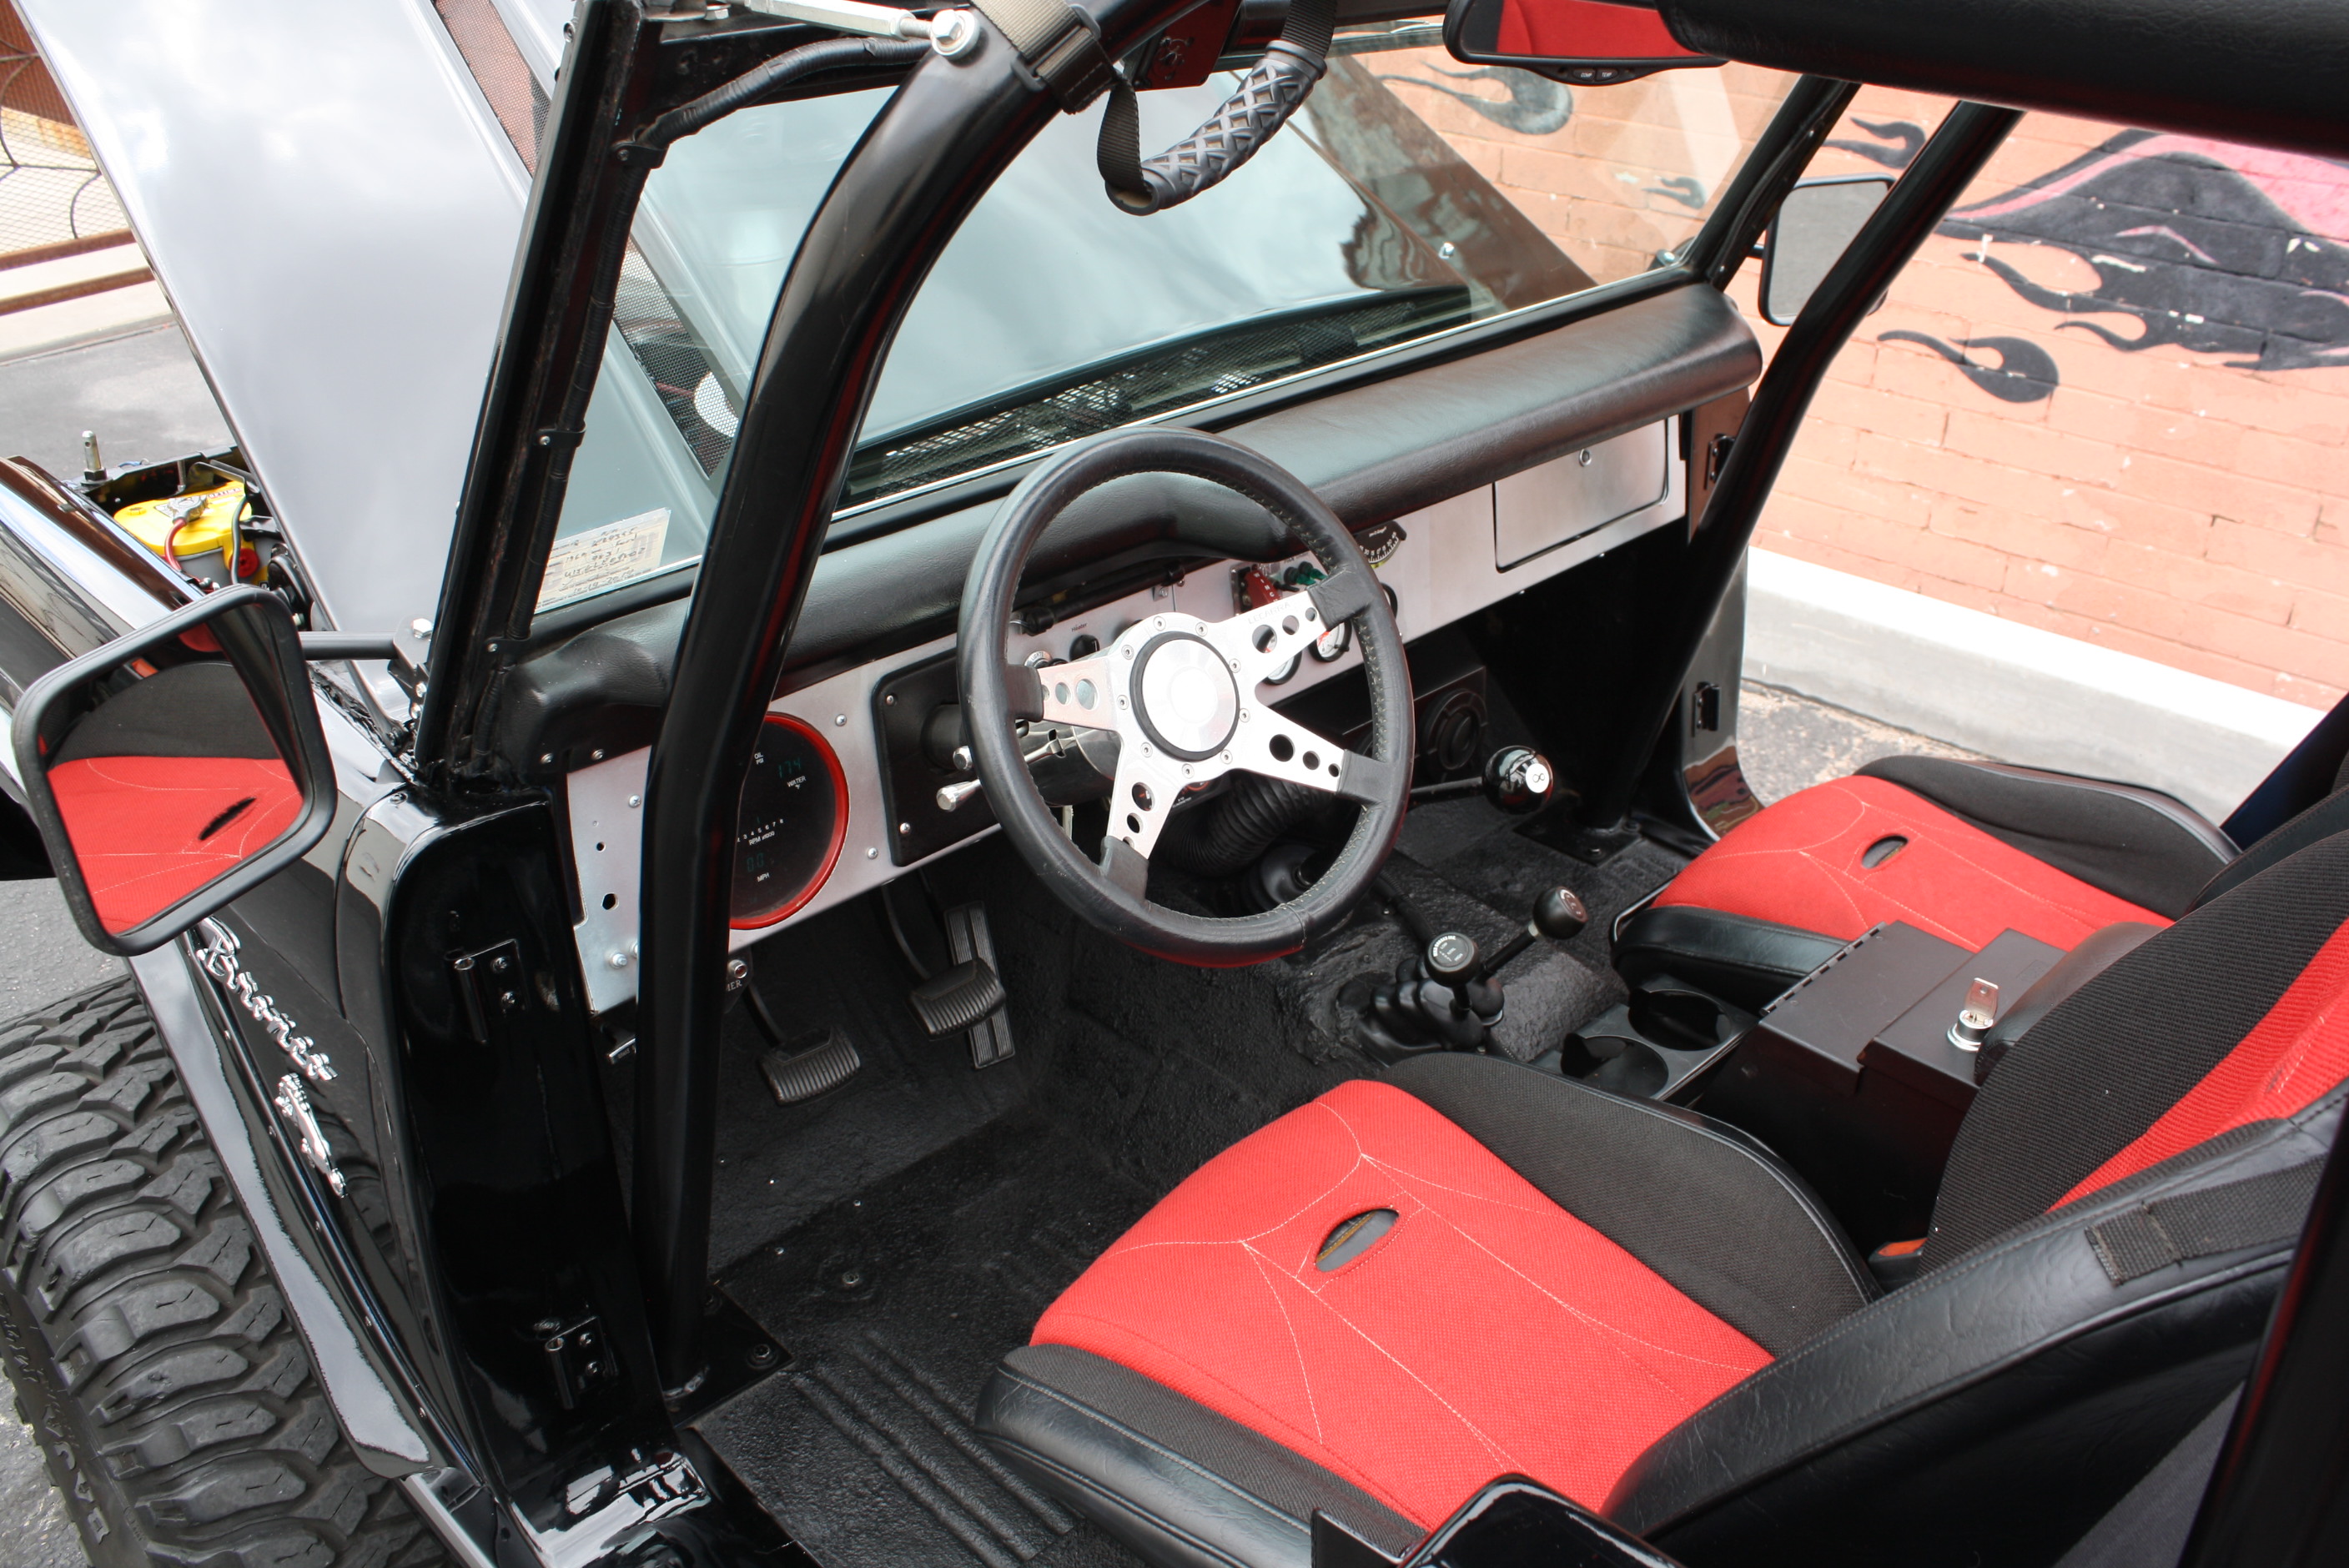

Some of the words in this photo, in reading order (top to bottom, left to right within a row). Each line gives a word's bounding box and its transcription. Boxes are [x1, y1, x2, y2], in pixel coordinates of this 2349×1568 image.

[1070, 622, 1089, 633] Heater
[787, 776, 807, 788] WATER
[748, 837, 762, 846] RPM
[757, 872, 770, 882] MPH
[196, 915, 339, 1081] Bronco
[43, 1404, 111, 1545] BAJA
